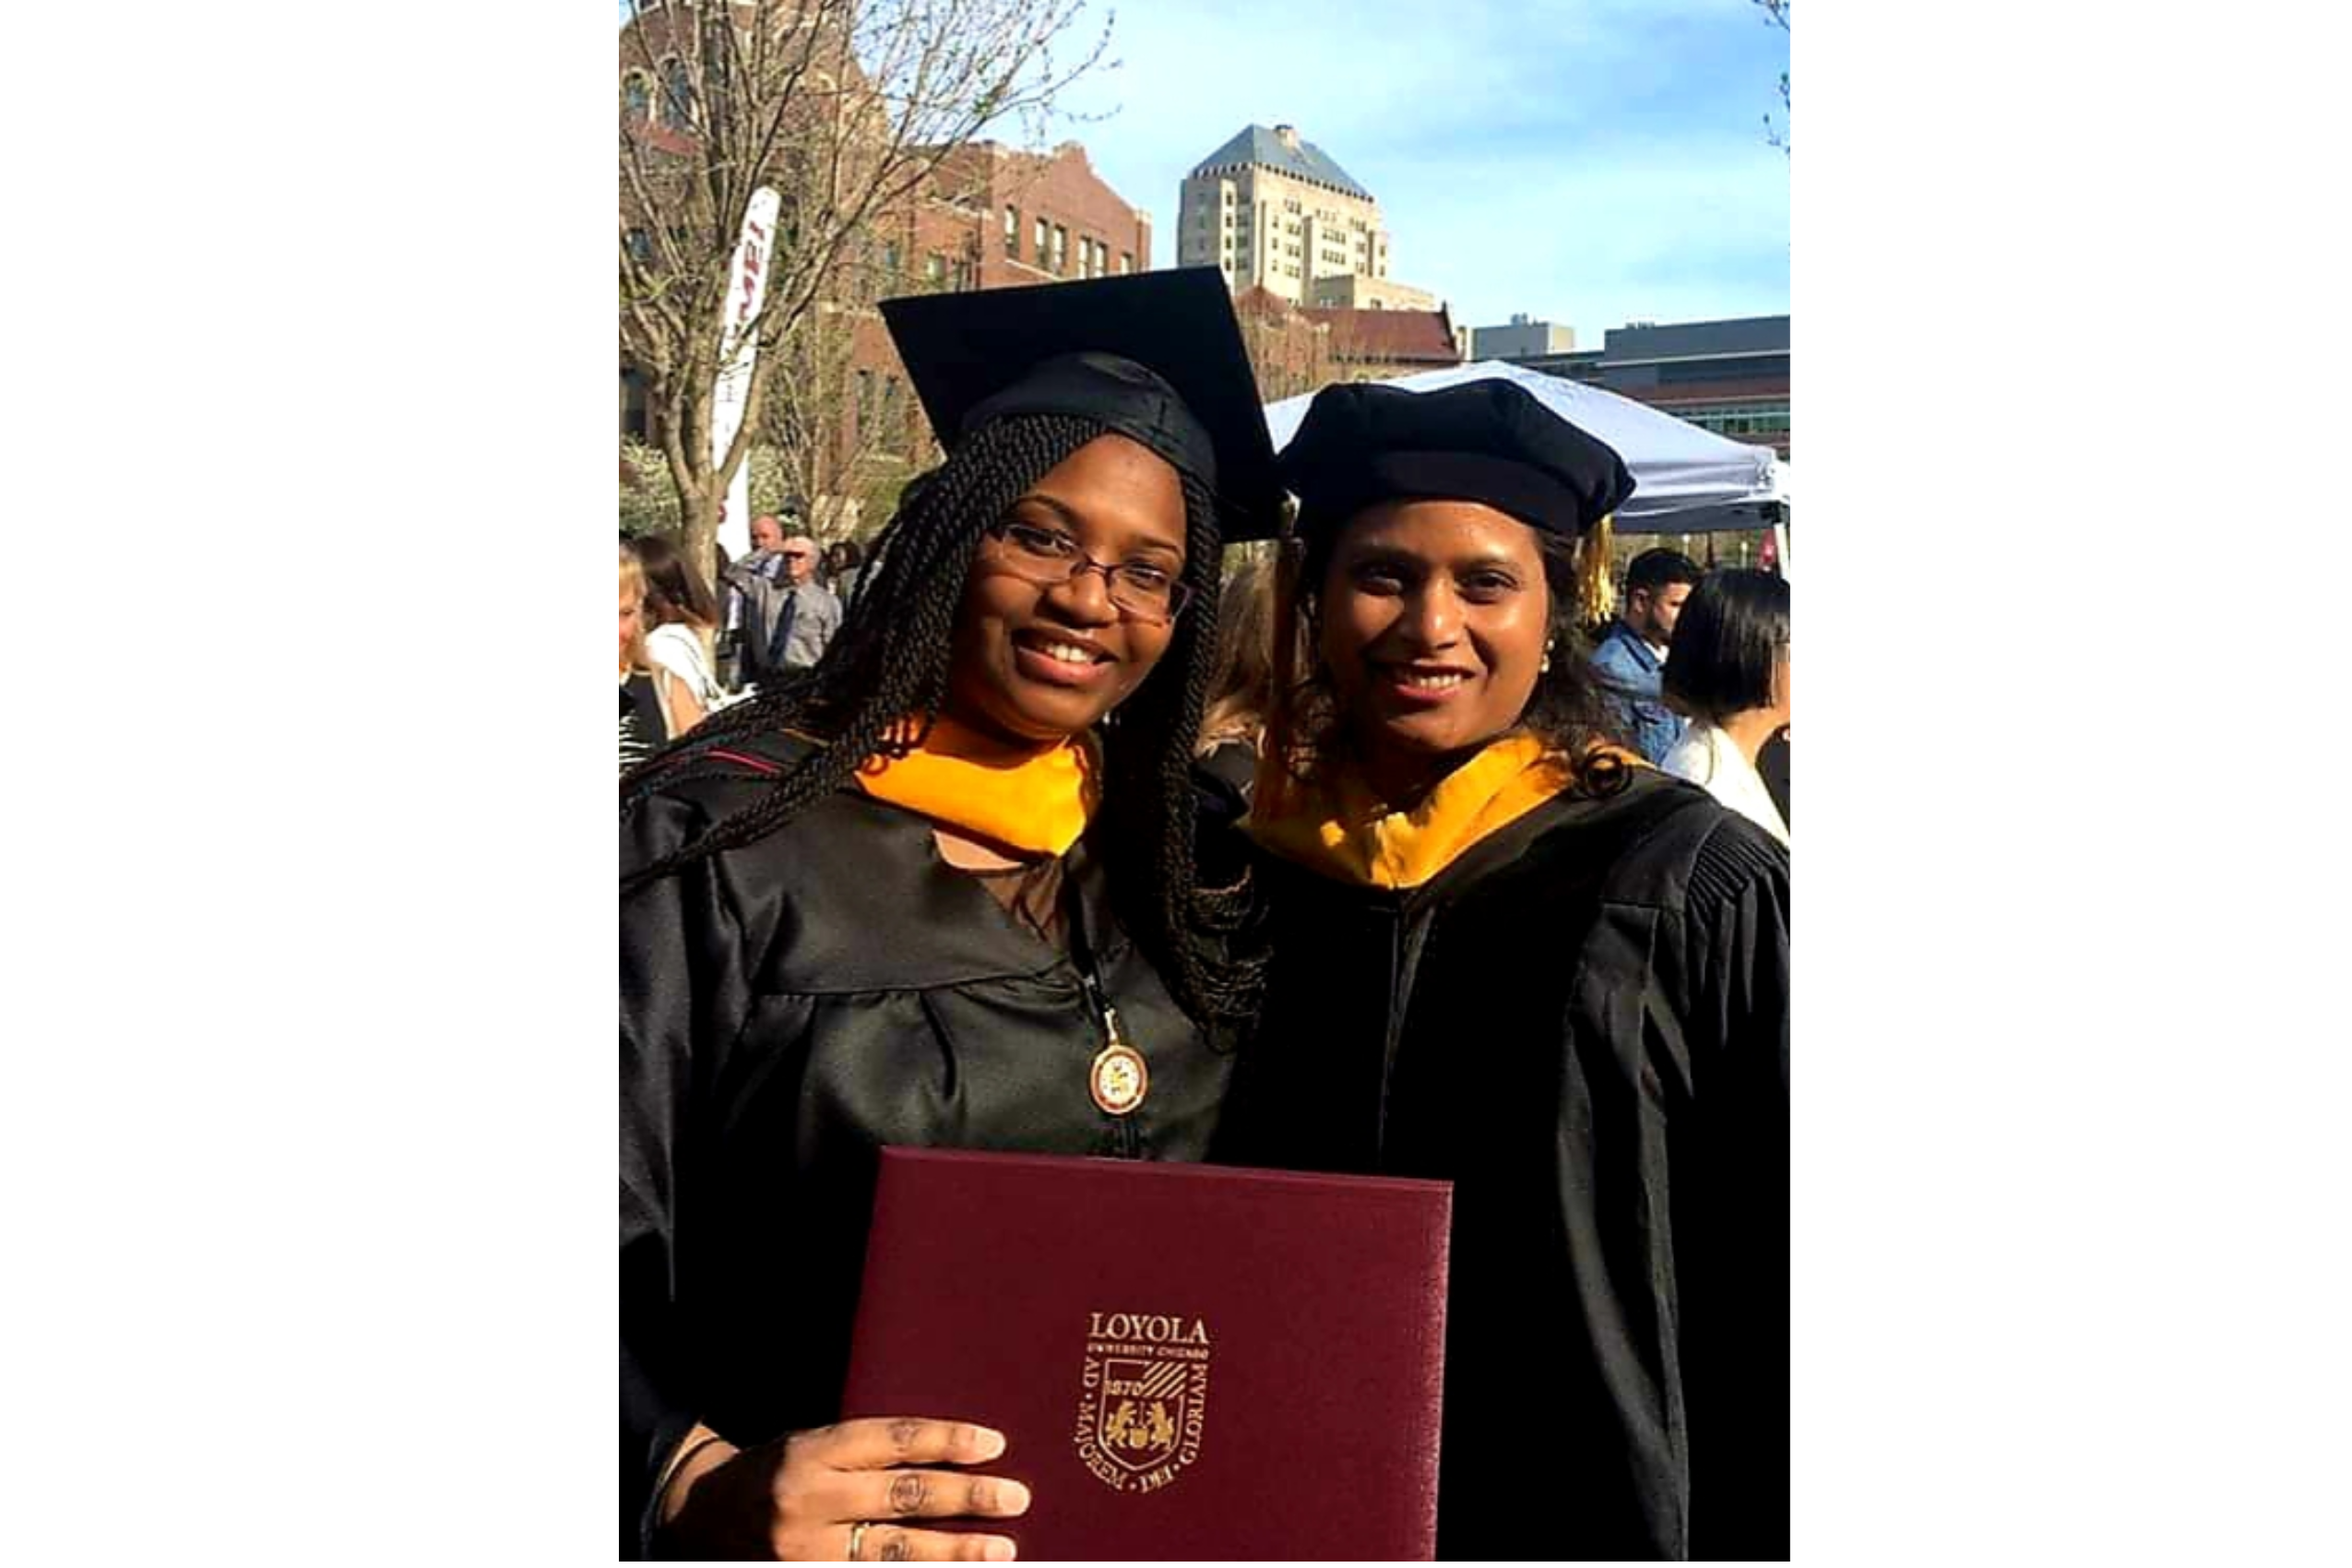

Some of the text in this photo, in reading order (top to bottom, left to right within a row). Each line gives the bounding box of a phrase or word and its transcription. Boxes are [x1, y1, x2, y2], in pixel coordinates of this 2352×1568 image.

[1088, 1312, 1209, 1344] LOYOLA
[1083, 1356, 1100, 1388] AD
[1178, 1362, 1208, 1465] GLORIAM
